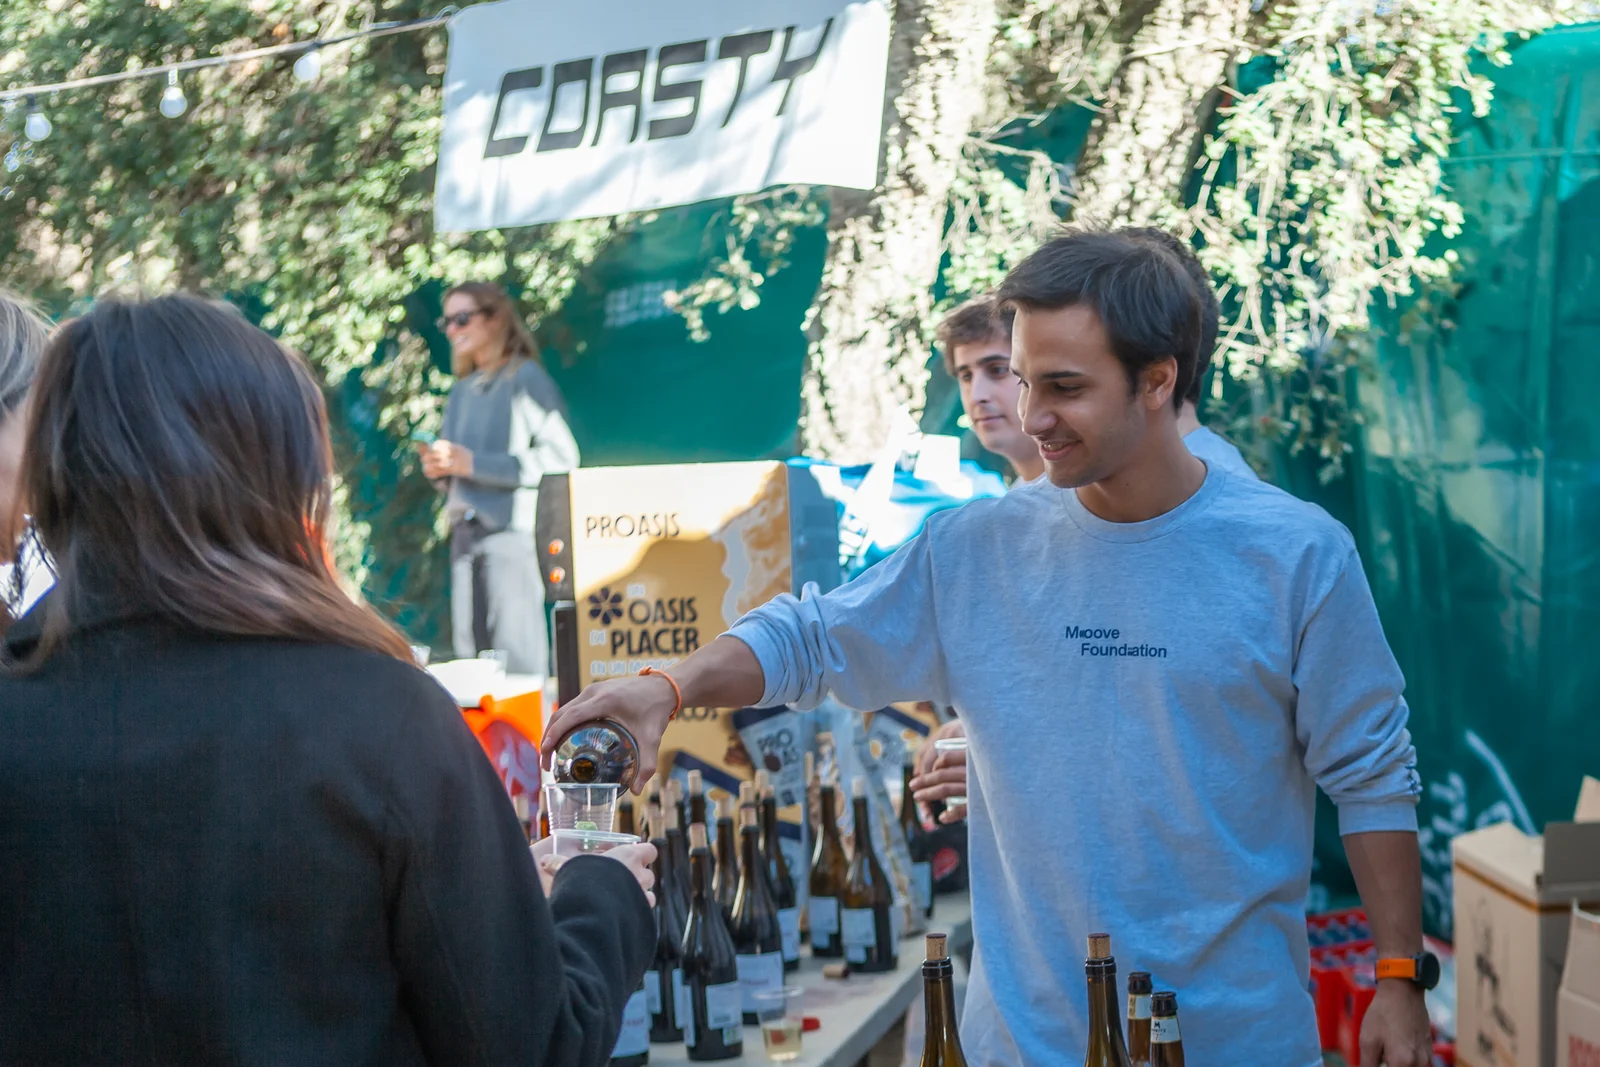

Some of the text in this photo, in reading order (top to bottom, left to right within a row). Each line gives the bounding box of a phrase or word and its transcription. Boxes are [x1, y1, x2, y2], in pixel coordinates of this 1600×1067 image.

[483, 17, 834, 159] COASTY
[586, 513, 680, 538] PROASIS
[628, 597, 698, 625] OASIS
[610, 628, 699, 657] PLACER
[1081, 643, 1167, 657] Foundation
